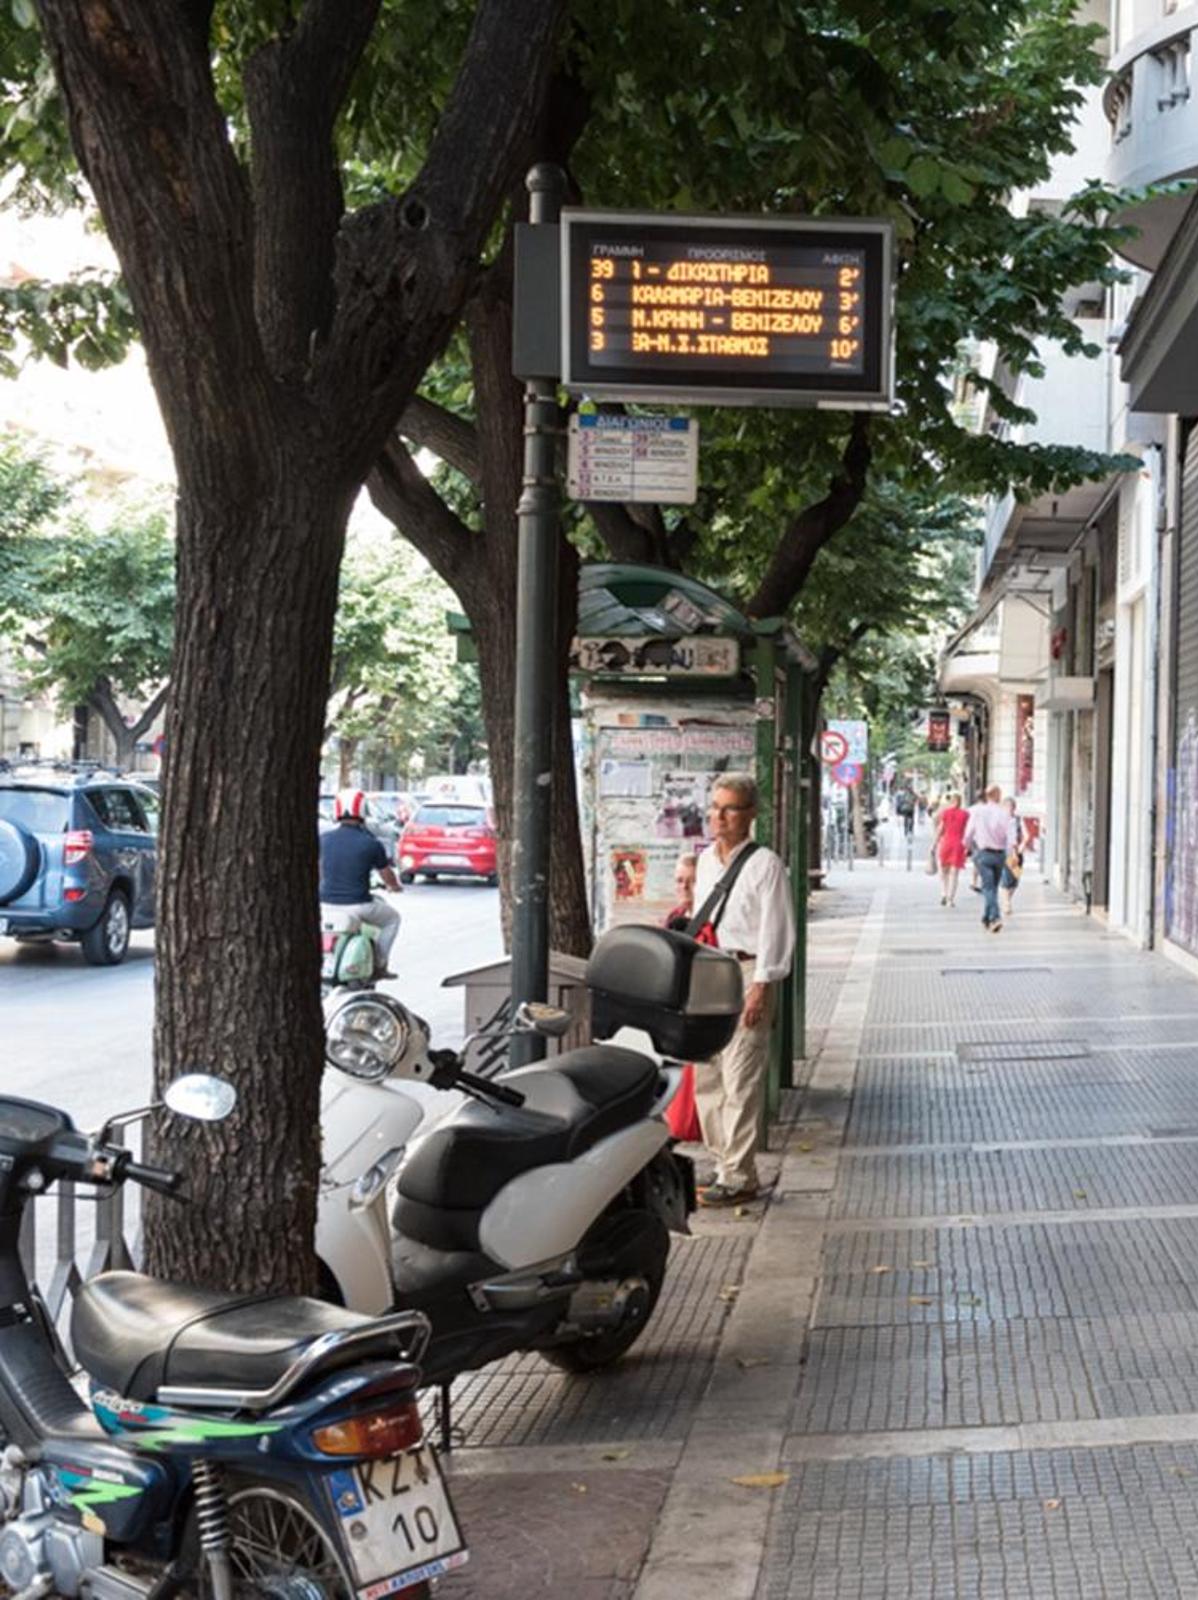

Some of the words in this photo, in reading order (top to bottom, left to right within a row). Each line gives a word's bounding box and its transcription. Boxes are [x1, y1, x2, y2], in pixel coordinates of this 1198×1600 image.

[593, 244, 644, 257] ΓΡΑΜΜΗ
[591, 259, 614, 279] 39
[667, 262, 768, 285] ΔΙΚΑΣΤΗΡΙΑ
[591, 283, 605, 302] 6
[731, 312, 823, 334] ΒΕΝΙΖΕΛΟΥ
[591, 331, 605, 351] 3
[358, 1448, 429, 1505] KZT
[392, 1505, 438, 1551] 10
